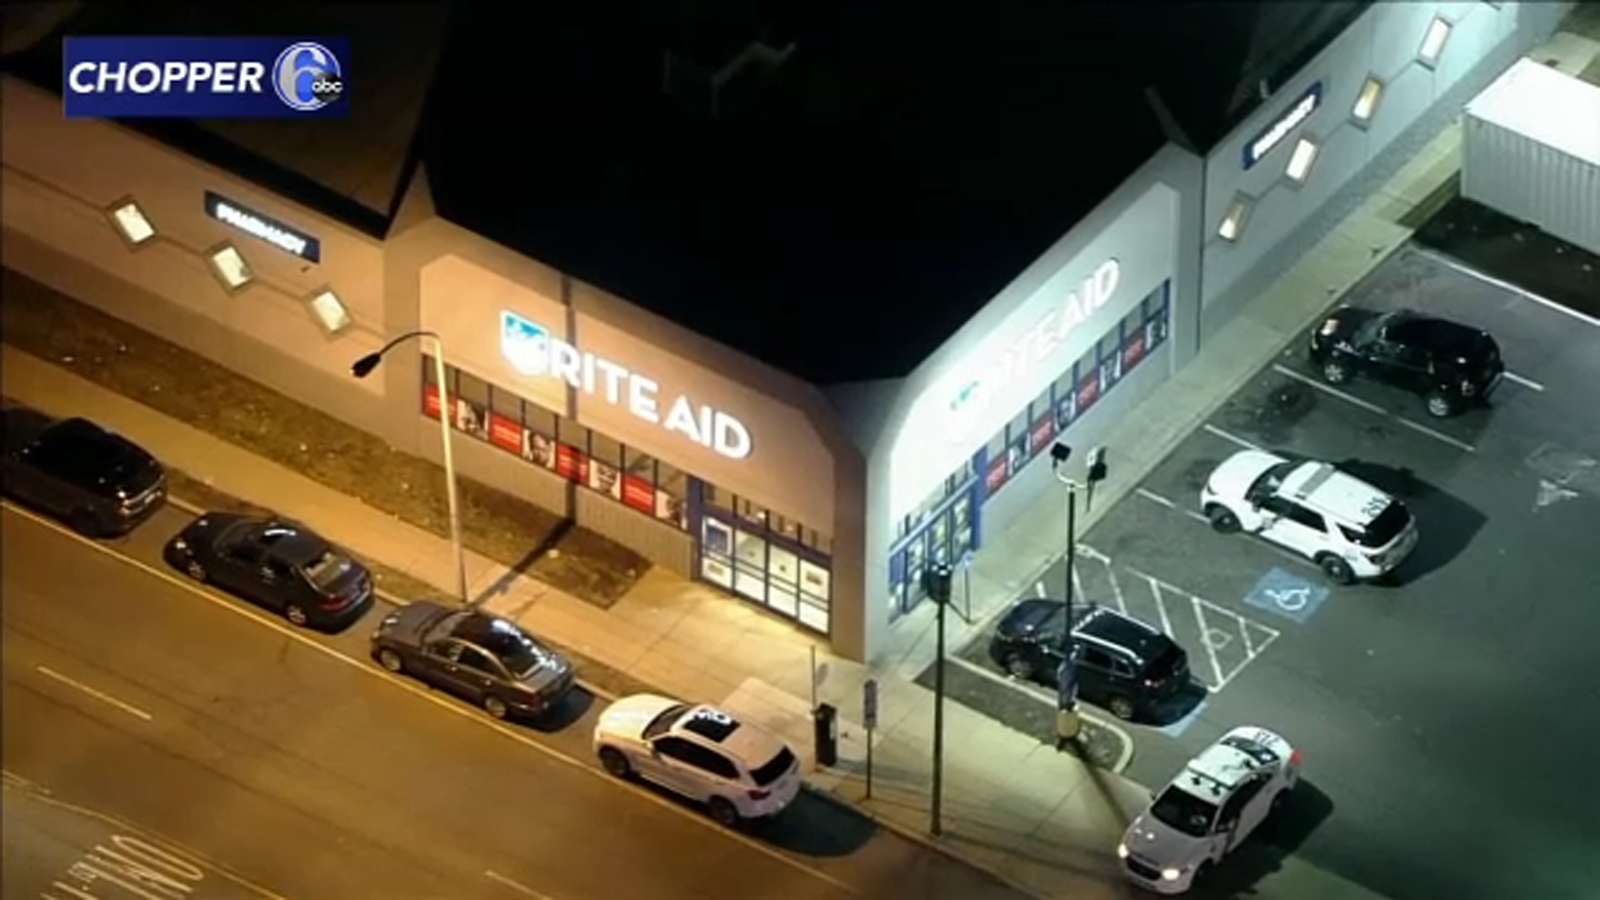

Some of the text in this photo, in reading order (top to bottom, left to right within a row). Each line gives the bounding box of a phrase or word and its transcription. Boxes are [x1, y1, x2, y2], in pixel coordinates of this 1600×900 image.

[1058, 260, 1119, 340] AID
[551, 338, 752, 459] RITE AID
